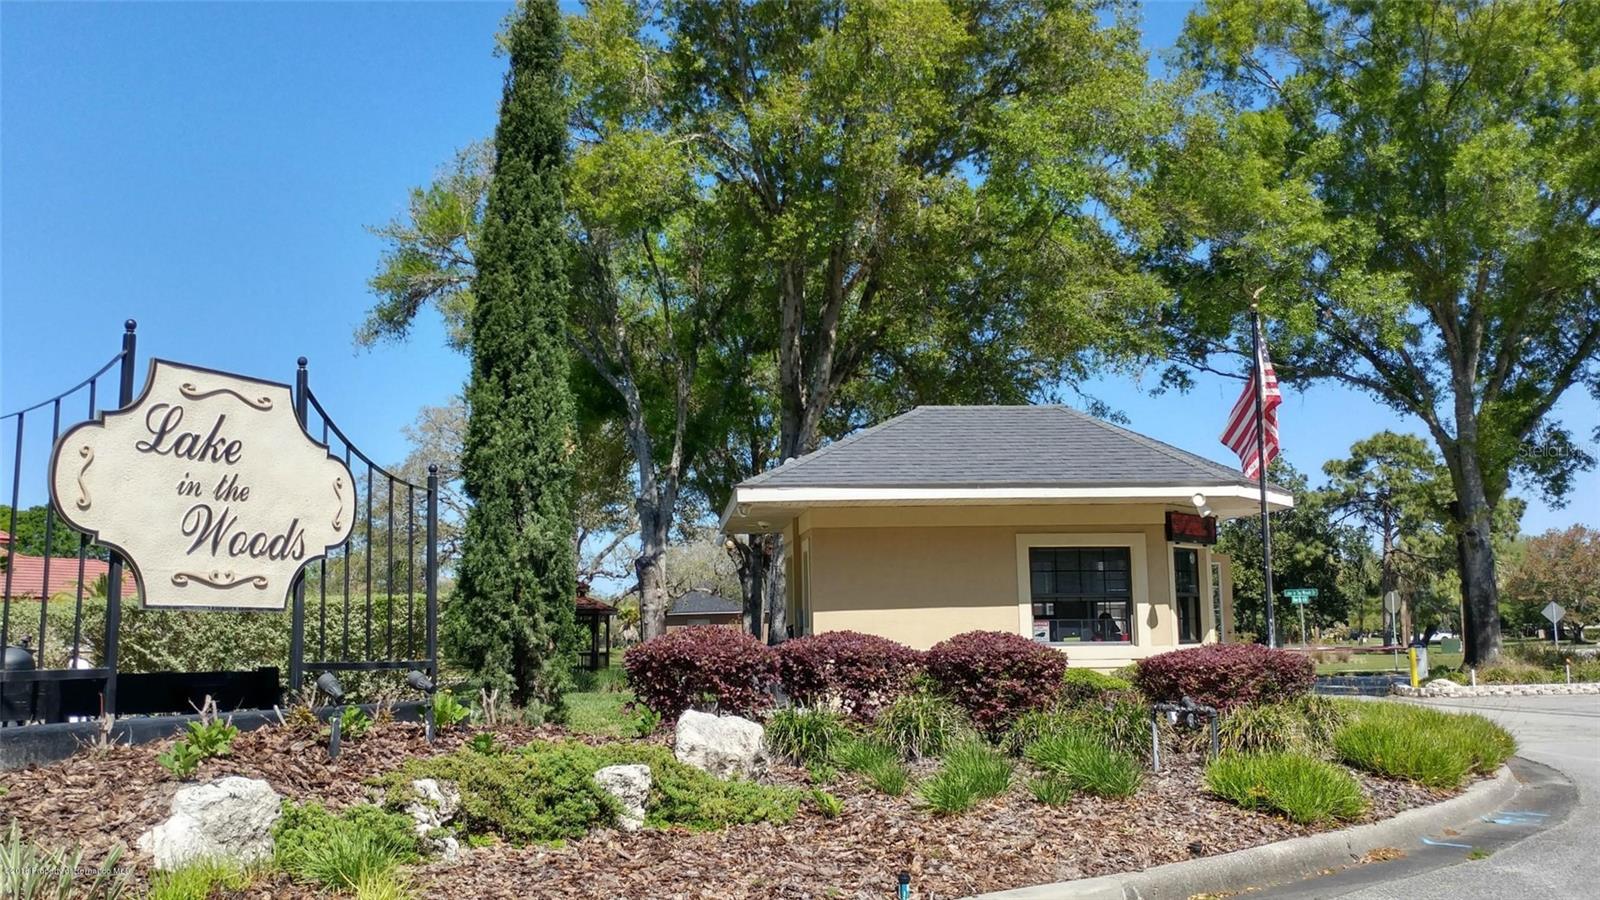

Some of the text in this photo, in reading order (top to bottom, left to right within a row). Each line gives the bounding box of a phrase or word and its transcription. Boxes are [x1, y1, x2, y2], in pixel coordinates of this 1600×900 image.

[135, 403, 243, 465] Lake
[176, 472, 250, 502] in the
[181, 504, 306, 562] Woods
